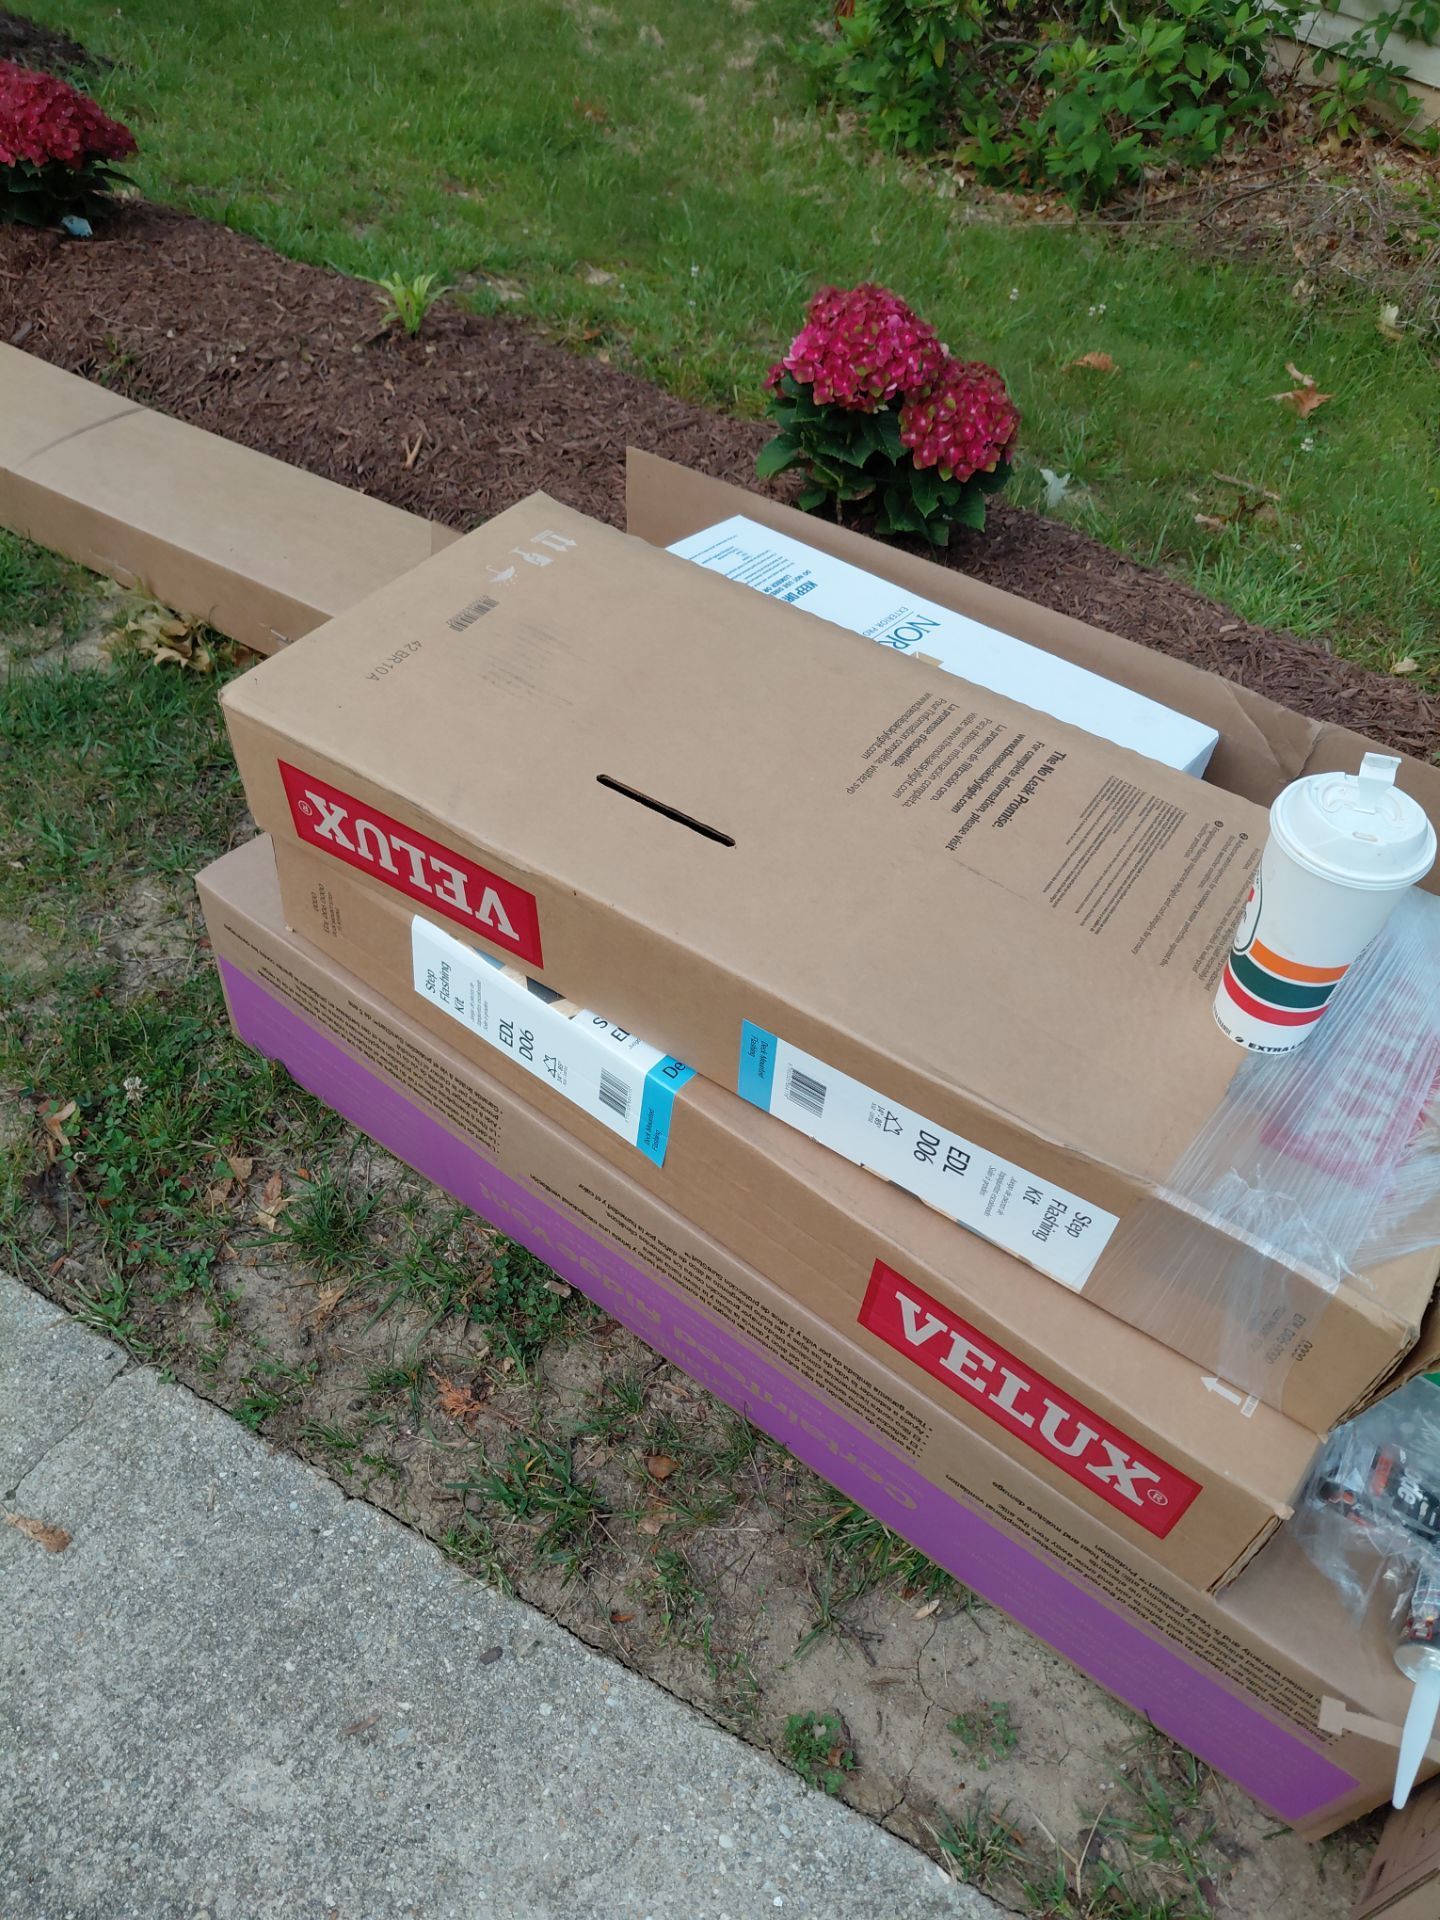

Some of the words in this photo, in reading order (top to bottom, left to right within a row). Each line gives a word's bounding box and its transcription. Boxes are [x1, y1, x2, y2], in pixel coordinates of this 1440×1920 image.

[795, 580, 818, 596] KEEP
[879, 615, 941, 649] NOR
[993, 723, 1007, 733] La
[1029, 740, 1045, 752] For
[965, 752, 980, 763] de
[1006, 749, 1037, 778] complete
[1045, 749, 1067, 766] The
[1036, 763, 1055, 777] No
[975, 775, 1015, 815] information,
[1019, 774, 1045, 796] Leak
[990, 793, 1029, 831] Promise.
[957, 812, 983, 836] please
[944, 833, 965, 852] visit
[426, 969, 437, 993] Step
[440, 961, 451, 1004] Flashing
[454, 997, 465, 1014] Kit
[499, 1019, 514, 1047] EDL
[519, 1029, 534, 1062] D06
[1248, 1042, 1289, 1053] EXTRA
[913, 1129, 940, 1165] D06
[942, 1146, 971, 1176] EDL
[1022, 1185, 1044, 1206] Kit
[1032, 1198, 1068, 1242] Flashing
[1066, 1211, 1092, 1238] Step
[769, 1311, 788, 1329] años
[801, 1334, 817, 1349] vida
[833, 1366, 849, 1381] vida
[842, 1363, 872, 1389] limitada
[899, 1413, 924, 1435] Ayuda
[904, 1408, 927, 1428] Tiene
[989, 1480, 1027, 1507] damage
[1024, 1504, 1064, 1532] moisture
[1061, 1530, 1081, 1544] and
[1079, 1542, 1101, 1559] heat
[1092, 1543, 1139, 1577] Protection
[1099, 1556, 1122, 1573] from
[1140, 1584, 1185, 1618] protecting
[1221, 1632, 1241, 1648] and
[1240, 1645, 1282, 1677] warranty
[1244, 1657, 1265, 1673] and
[1282, 1674, 1314, 1699] limited
